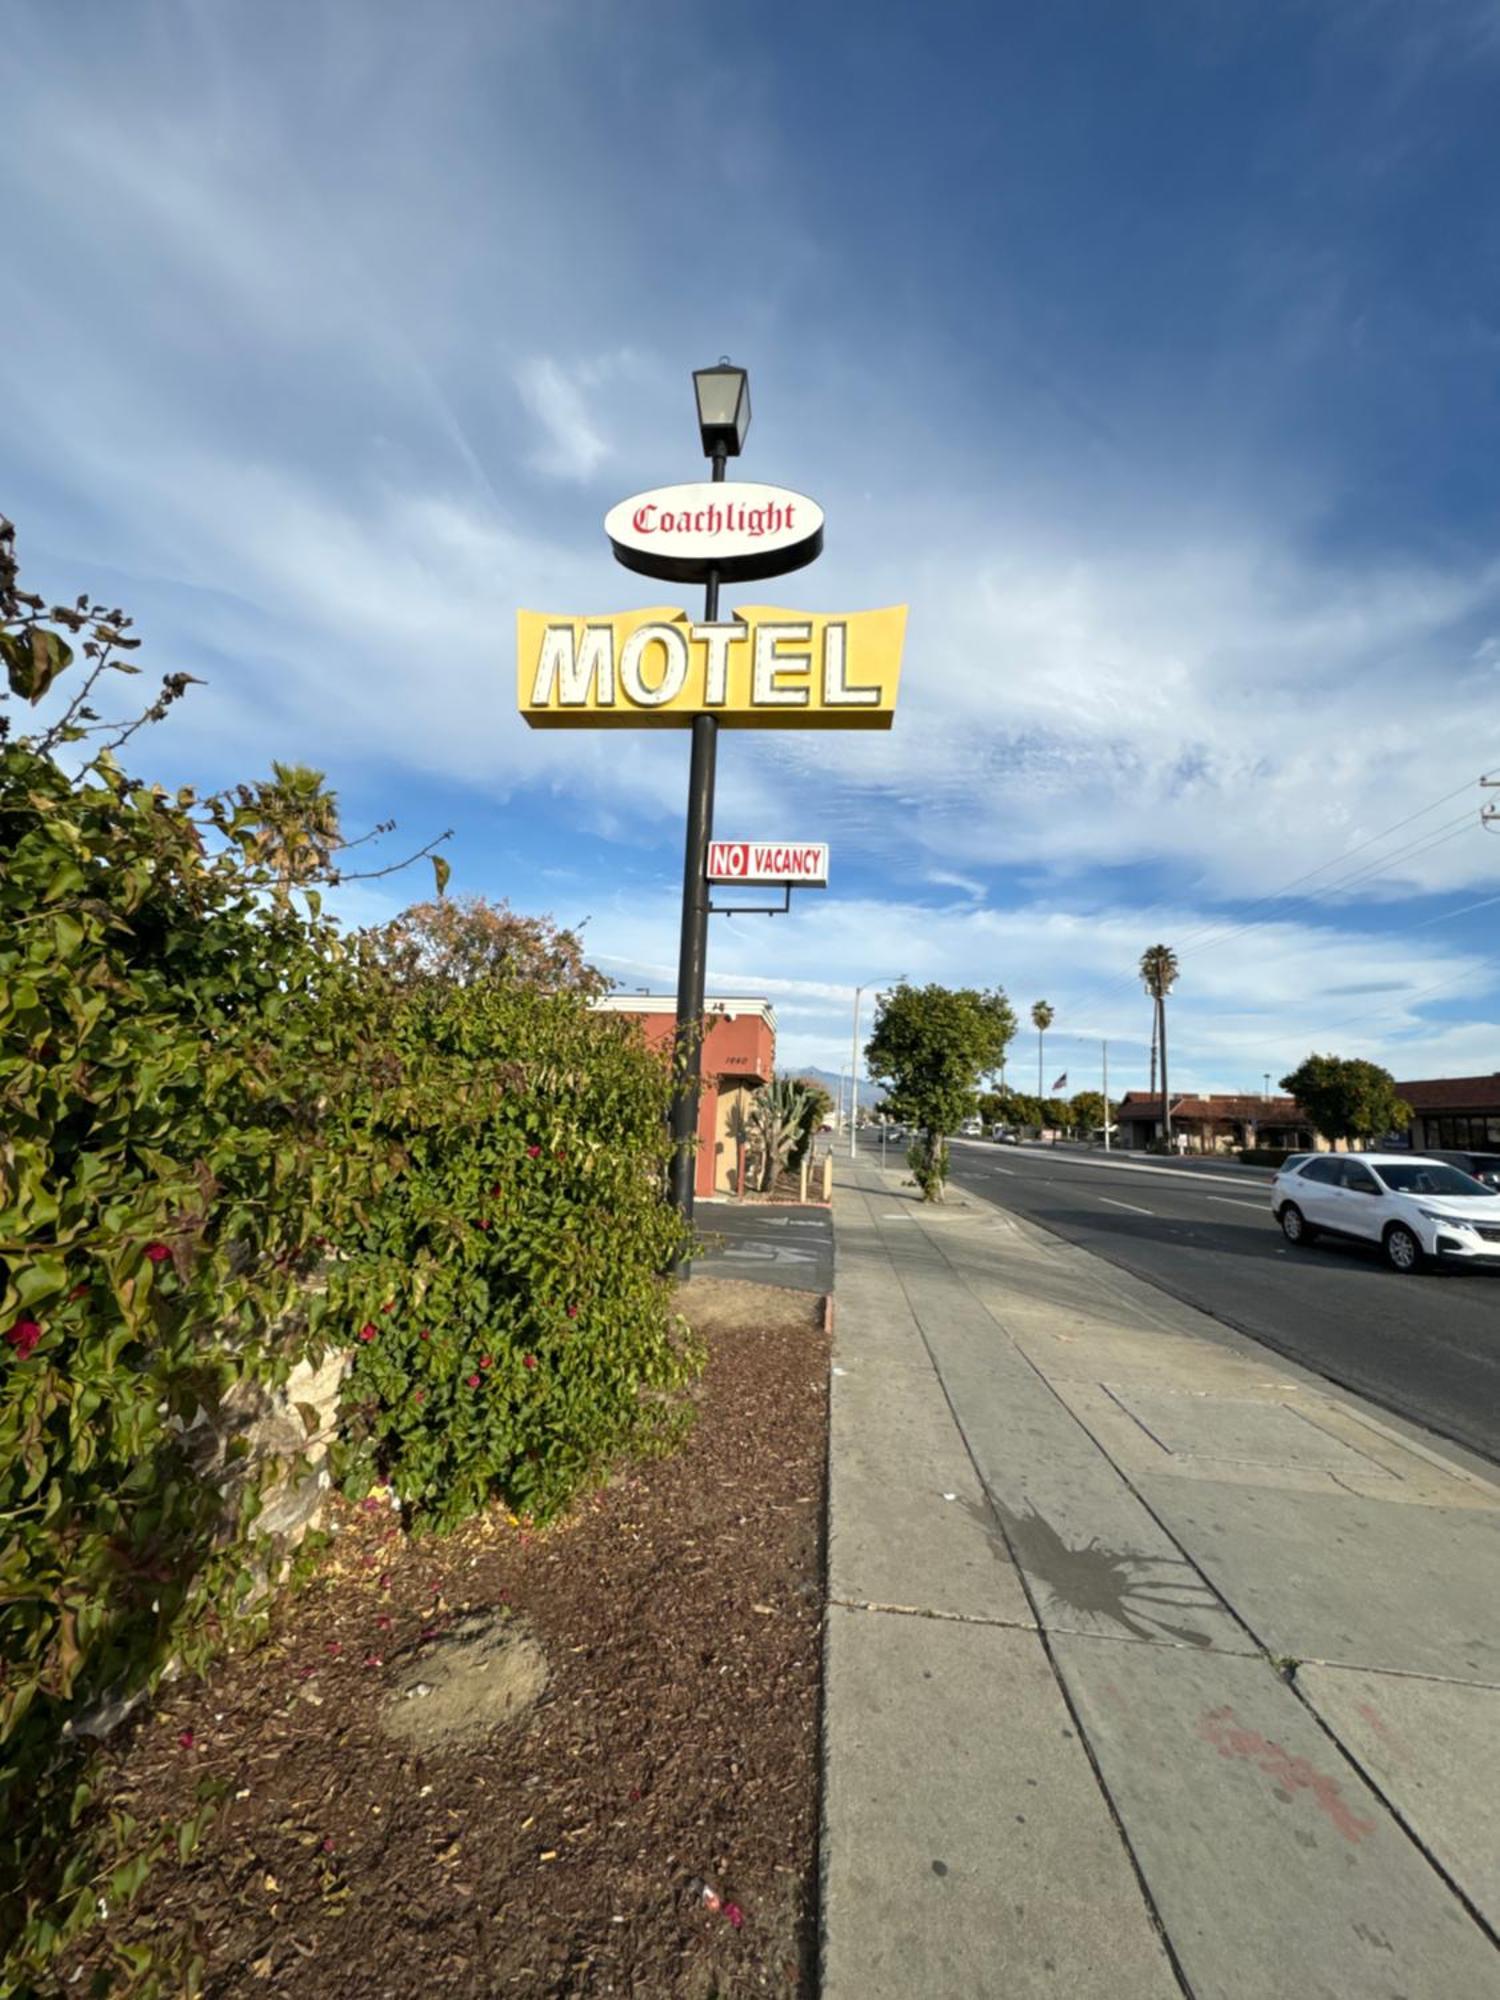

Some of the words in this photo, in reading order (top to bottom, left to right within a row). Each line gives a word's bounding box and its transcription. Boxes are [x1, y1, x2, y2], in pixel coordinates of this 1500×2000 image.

[632, 501, 796, 536] Coachlight
[530, 621, 881, 708] MOTEL
[712, 845, 745, 875] NO
[755, 849, 821, 874] VACANCY
